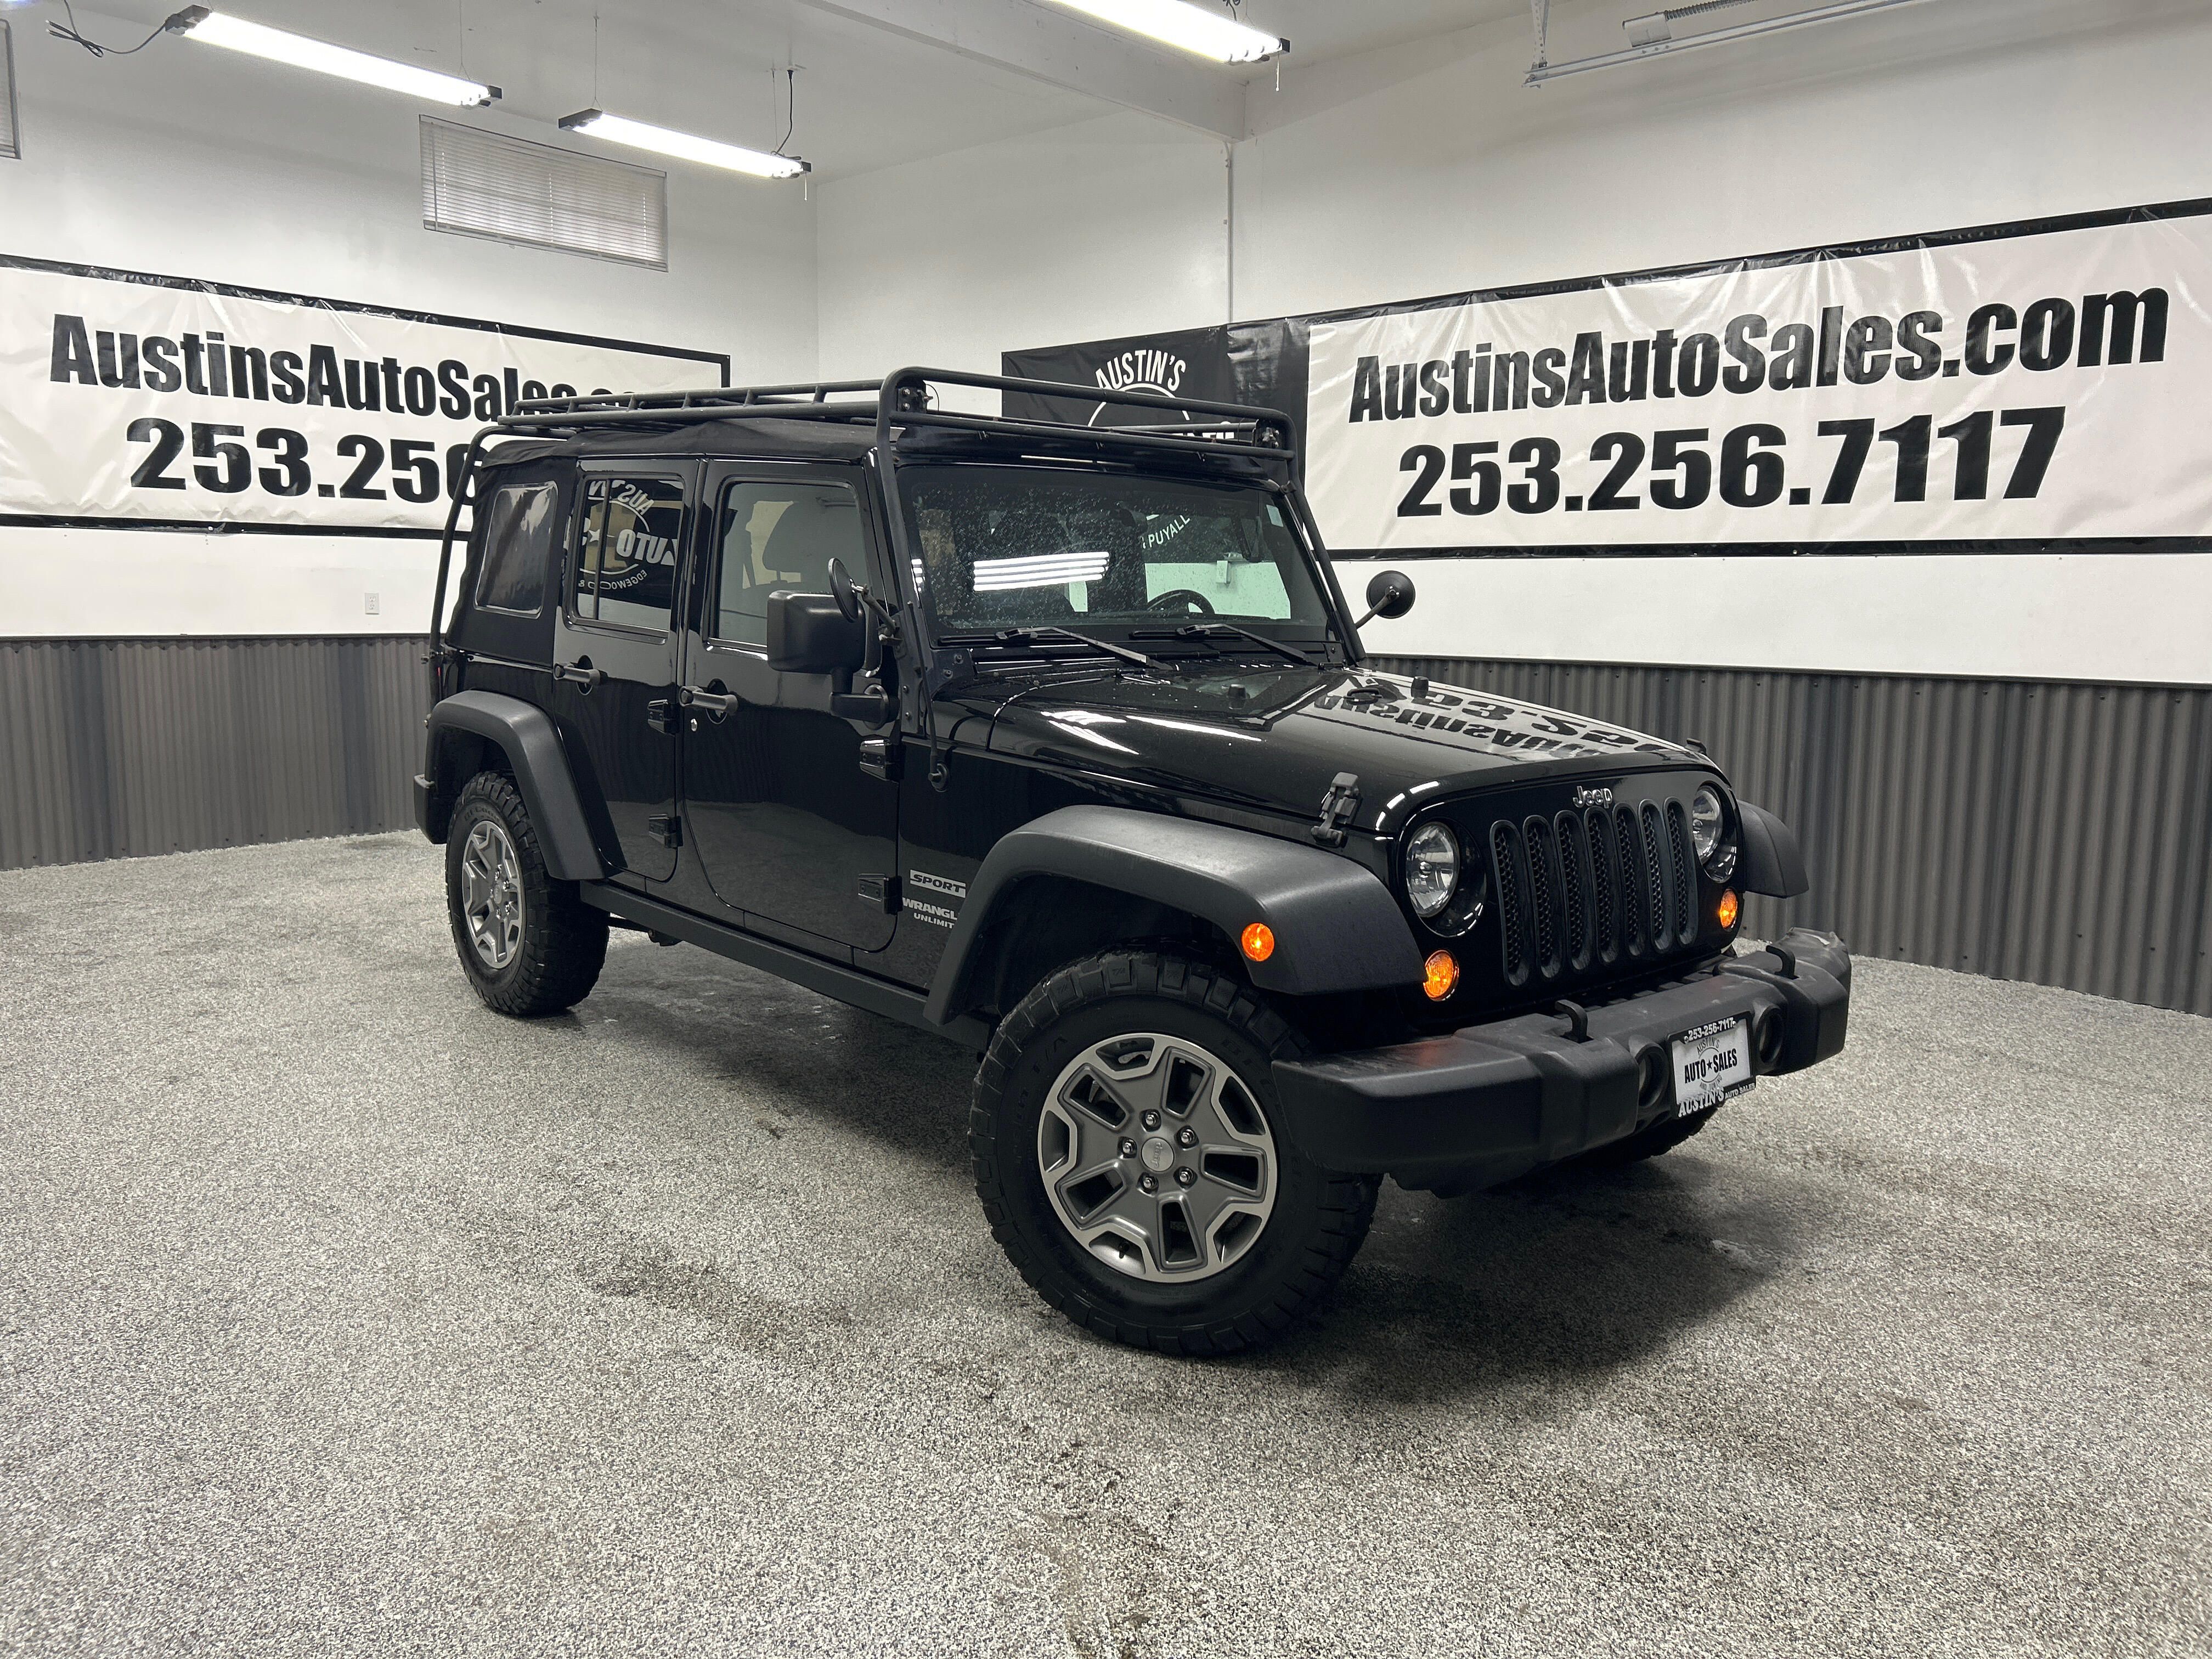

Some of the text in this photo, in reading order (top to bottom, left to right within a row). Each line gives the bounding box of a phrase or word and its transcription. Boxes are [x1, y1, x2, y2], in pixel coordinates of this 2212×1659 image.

[1095, 349, 1186, 391] AUSTIN'S
[1348, 286, 2170, 424] AustinsAutoSales.com
[1397, 405, 2067, 517] 253.256.7117
[1148, 515, 1191, 548] PUYALL
[1572, 785, 1613, 809] Jeep
[912, 873, 966, 893] SPORT
[902, 897, 958, 920] WRANGL
[913, 912, 955, 929] UNLIMIT
[1688, 1017, 1734, 1041] 253-256-7117
[1684, 1048, 1738, 1084] AUTO SALES
[1678, 1082, 1756, 1118] AUSTIN'S AUTO SALES
